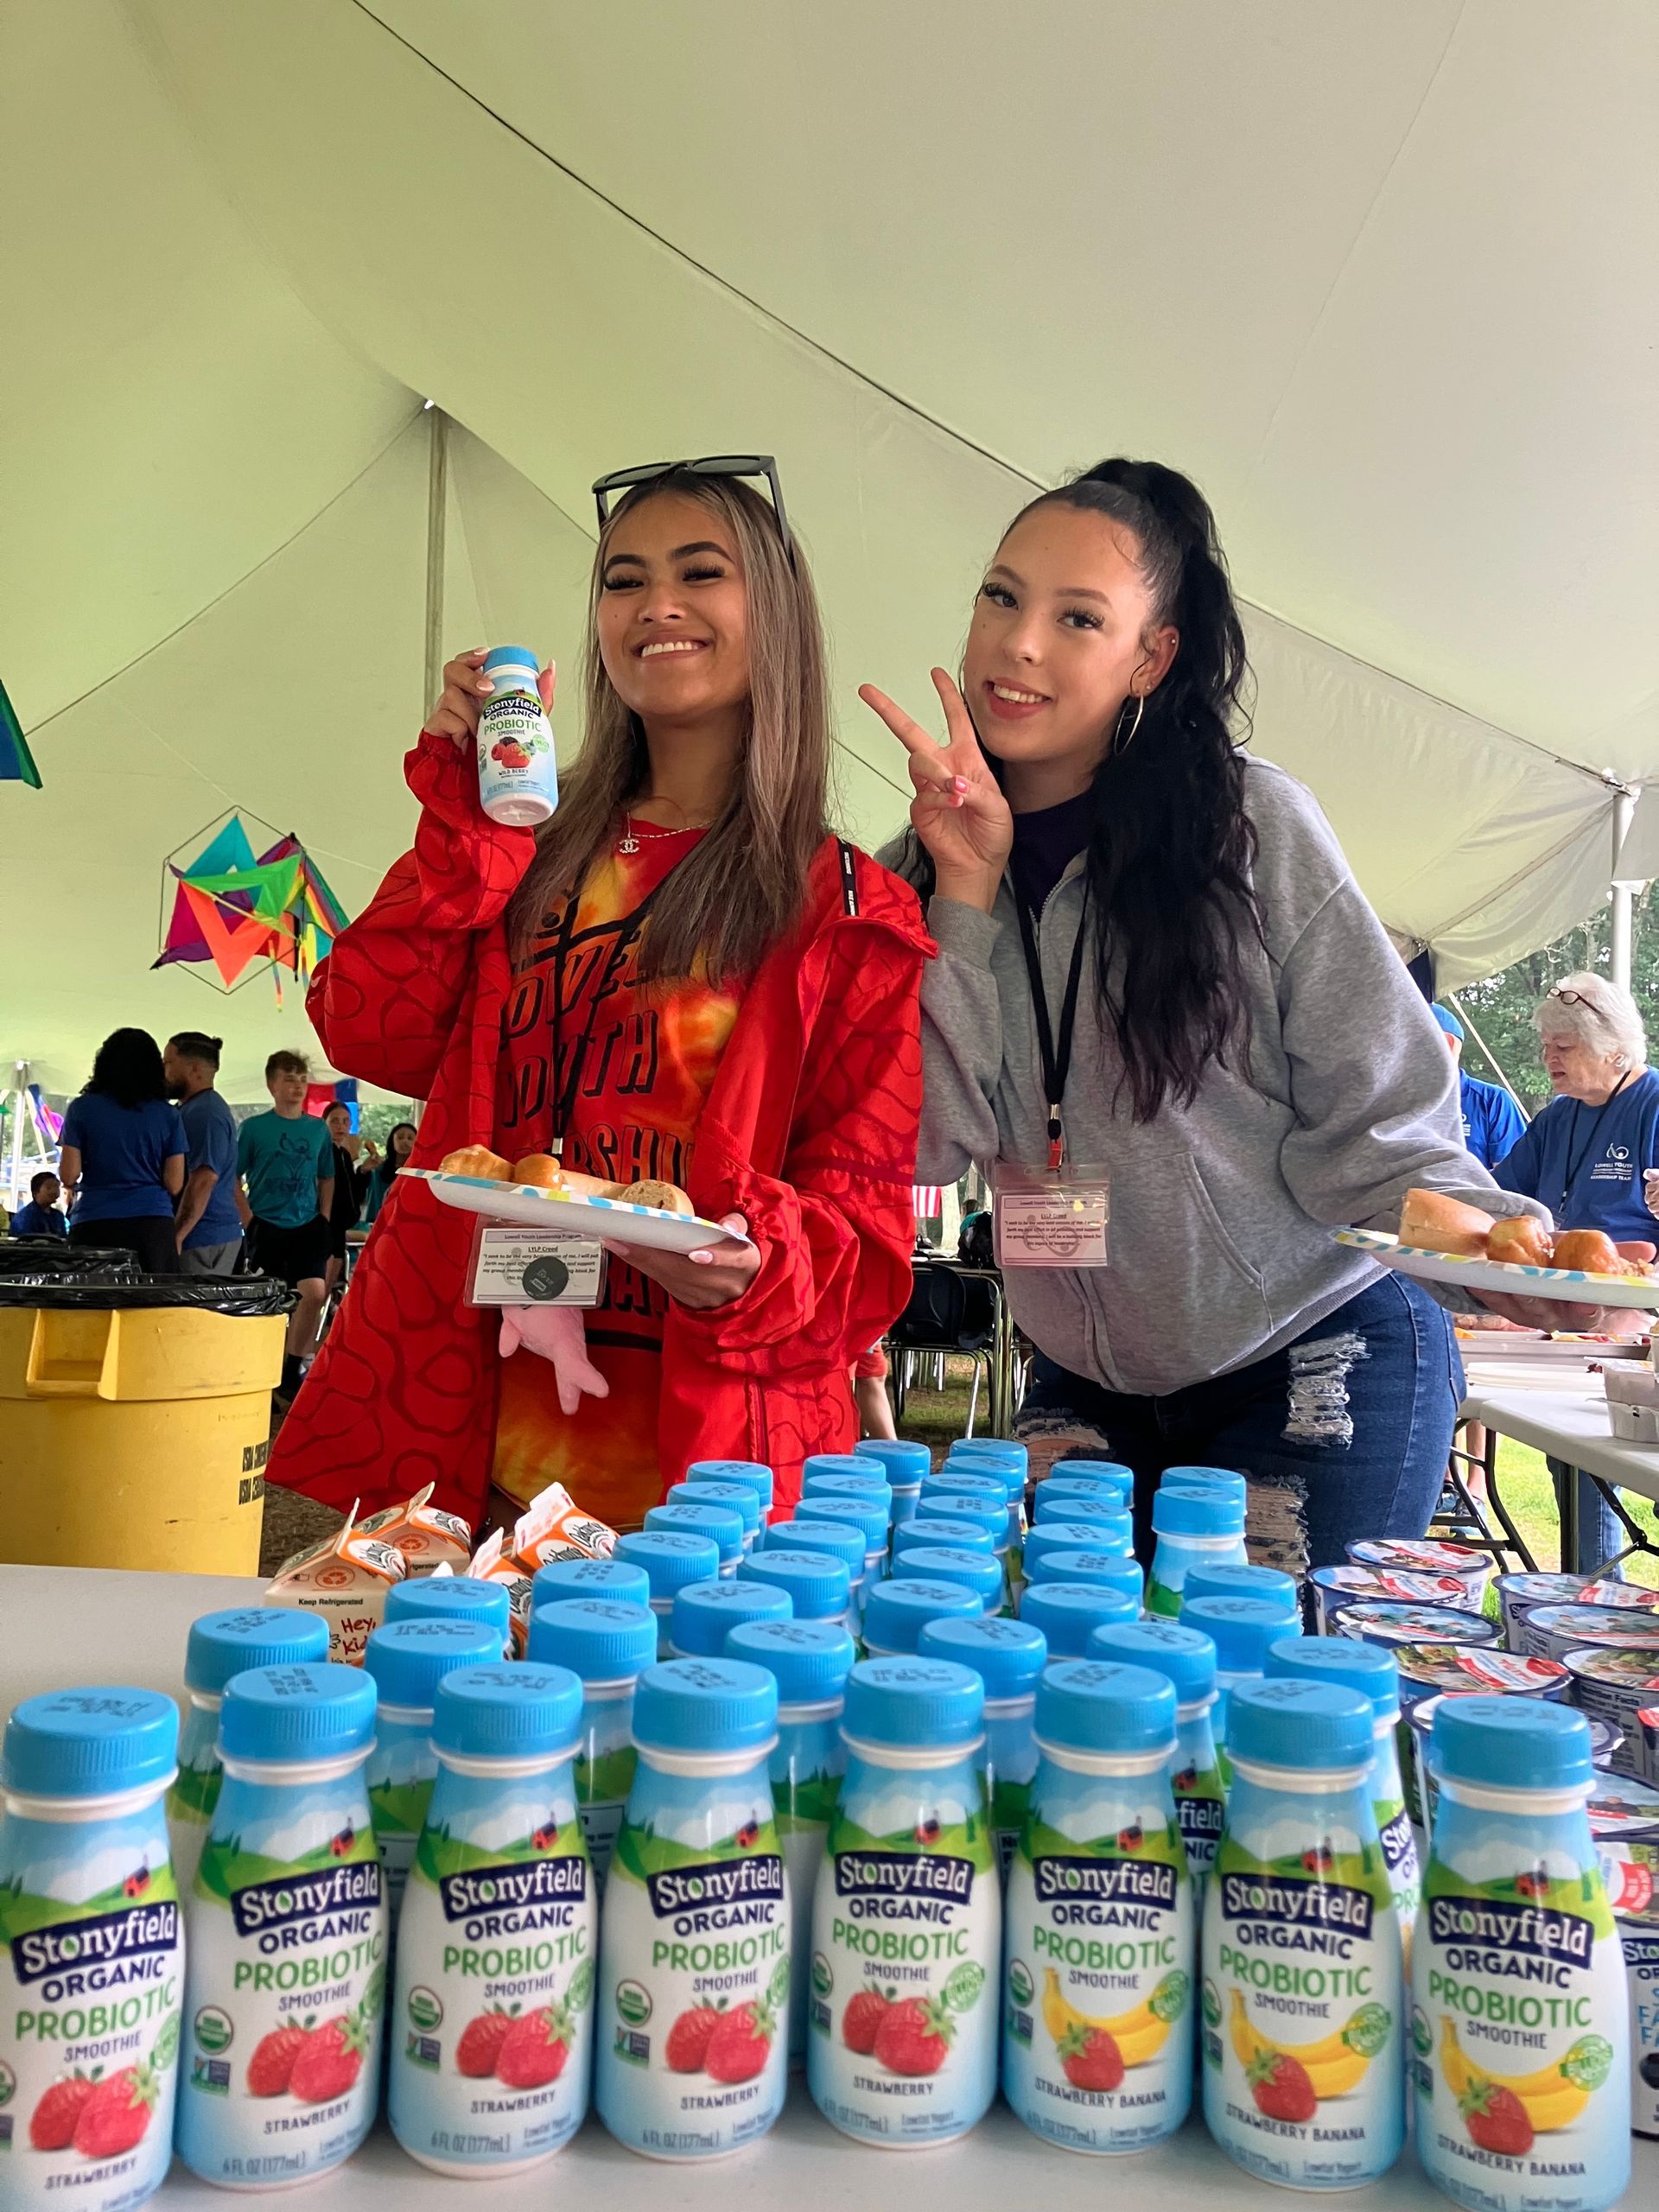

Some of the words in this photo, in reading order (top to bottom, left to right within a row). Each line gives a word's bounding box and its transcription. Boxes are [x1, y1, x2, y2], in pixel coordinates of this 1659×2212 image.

[485, 698, 539, 716] Stonyfield
[490, 709, 534, 721] ORGANIC
[484, 719, 542, 735] PROBIOTIC
[1179, 1800, 1223, 1832] field
[448, 1861, 582, 1912] Stonyfield
[655, 1859, 781, 1910] Stonyfield
[839, 1856, 969, 1895] Stonyfield
[1039, 1859, 1175, 1900] Stonyfield
[239, 1865, 378, 1929] Stonyfield
[849, 1898, 954, 1925] ORGANIC
[1225, 1878, 1368, 1926] Stonyfield
[259, 1911, 372, 1955] ORGANIC
[465, 1906, 574, 1942] ORGANIC
[673, 1903, 775, 1938] ORGANIC
[1052, 1904, 1161, 1931] ORGANIC
[1434, 1900, 1588, 1956] Stonyfield
[21, 1905, 175, 1974] Stonyfield
[443, 1925, 588, 1978] PROBIOTIC
[652, 1923, 785, 1972] PROBIOTIC
[832, 1917, 969, 1962] PROBIOTIC
[1033, 1926, 1176, 1970] PROBIOTIC
[1236, 1923, 1354, 1961] ORGANIC
[41, 1956, 165, 2003] ORGANIC
[234, 1931, 383, 1991] PROBIOTIC
[864, 1961, 930, 1981] SMOOTHIE
[1069, 1969, 1139, 1990] SMOOTHIE
[1220, 1944, 1372, 1998] PROBIOTIC
[1446, 1949, 1573, 1988] ORGANIC
[277, 1981, 351, 2012] SMOOTHIE
[485, 1974, 556, 1999] SMOOTHIE
[692, 1968, 759, 1993] SMOOTHIE
[15, 1976, 176, 2042] PROBIOTIC
[1255, 1993, 1330, 2018] SMOOTHIE
[1429, 1970, 1593, 2029] PROBIOTIC
[63, 2031, 142, 2063] SMOOTHIE
[1466, 2020, 1548, 2050] SMOOTHIE
[471, 2090, 556, 2114] STRAWBERRY
[681, 2086, 760, 2110] STRAWBERRY
[854, 2075, 934, 2096] STRAWBERRY
[1035, 2077, 1115, 2108] STRAWBERRY
[1120, 2089, 1166, 2108] BANANA
[264, 2100, 351, 2135] STRAWBERRY
[1226, 2102, 1307, 2140] STRAWBERRY
[1313, 2127, 1366, 2142] BANANA
[1438, 2133, 1523, 2174] STRAWBERRY
[1530, 2162, 1586, 2176] BANANA
[45, 2158, 137, 2190] STRAWBERRY
